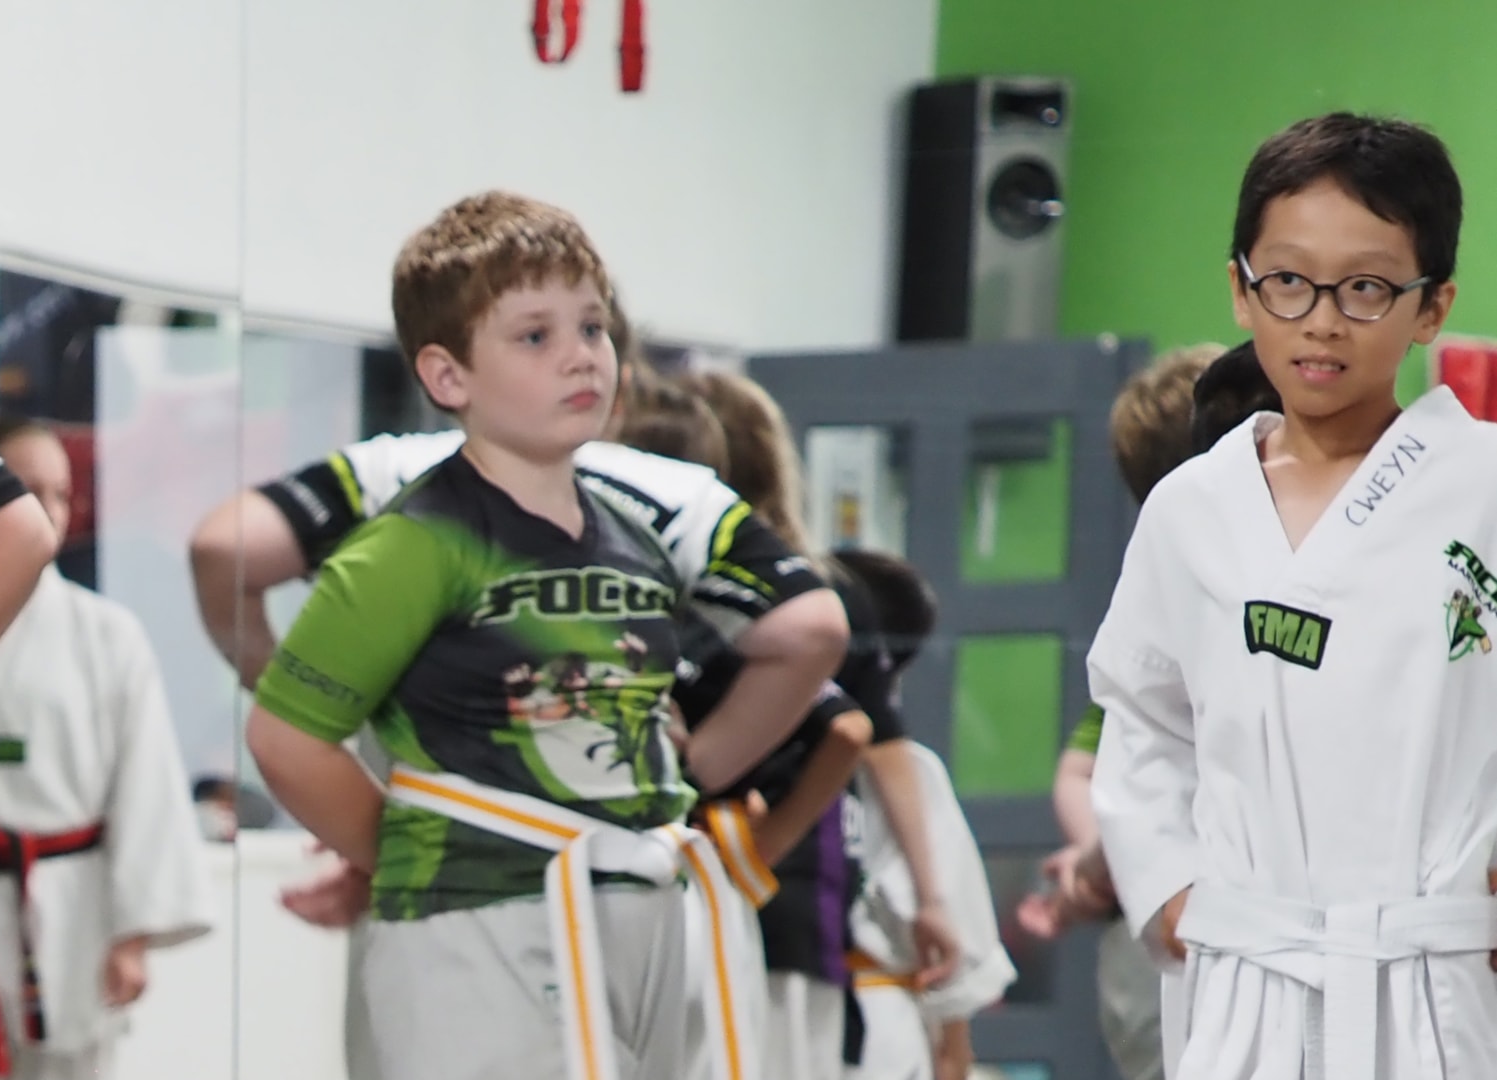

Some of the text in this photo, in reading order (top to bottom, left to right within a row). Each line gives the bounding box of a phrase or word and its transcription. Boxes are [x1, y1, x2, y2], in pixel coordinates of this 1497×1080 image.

[1345, 433, 1427, 527] CWEYN
[473, 566, 675, 625] FOCU
[1443, 539, 1497, 603] FOC
[1248, 603, 1324, 664] FMA
